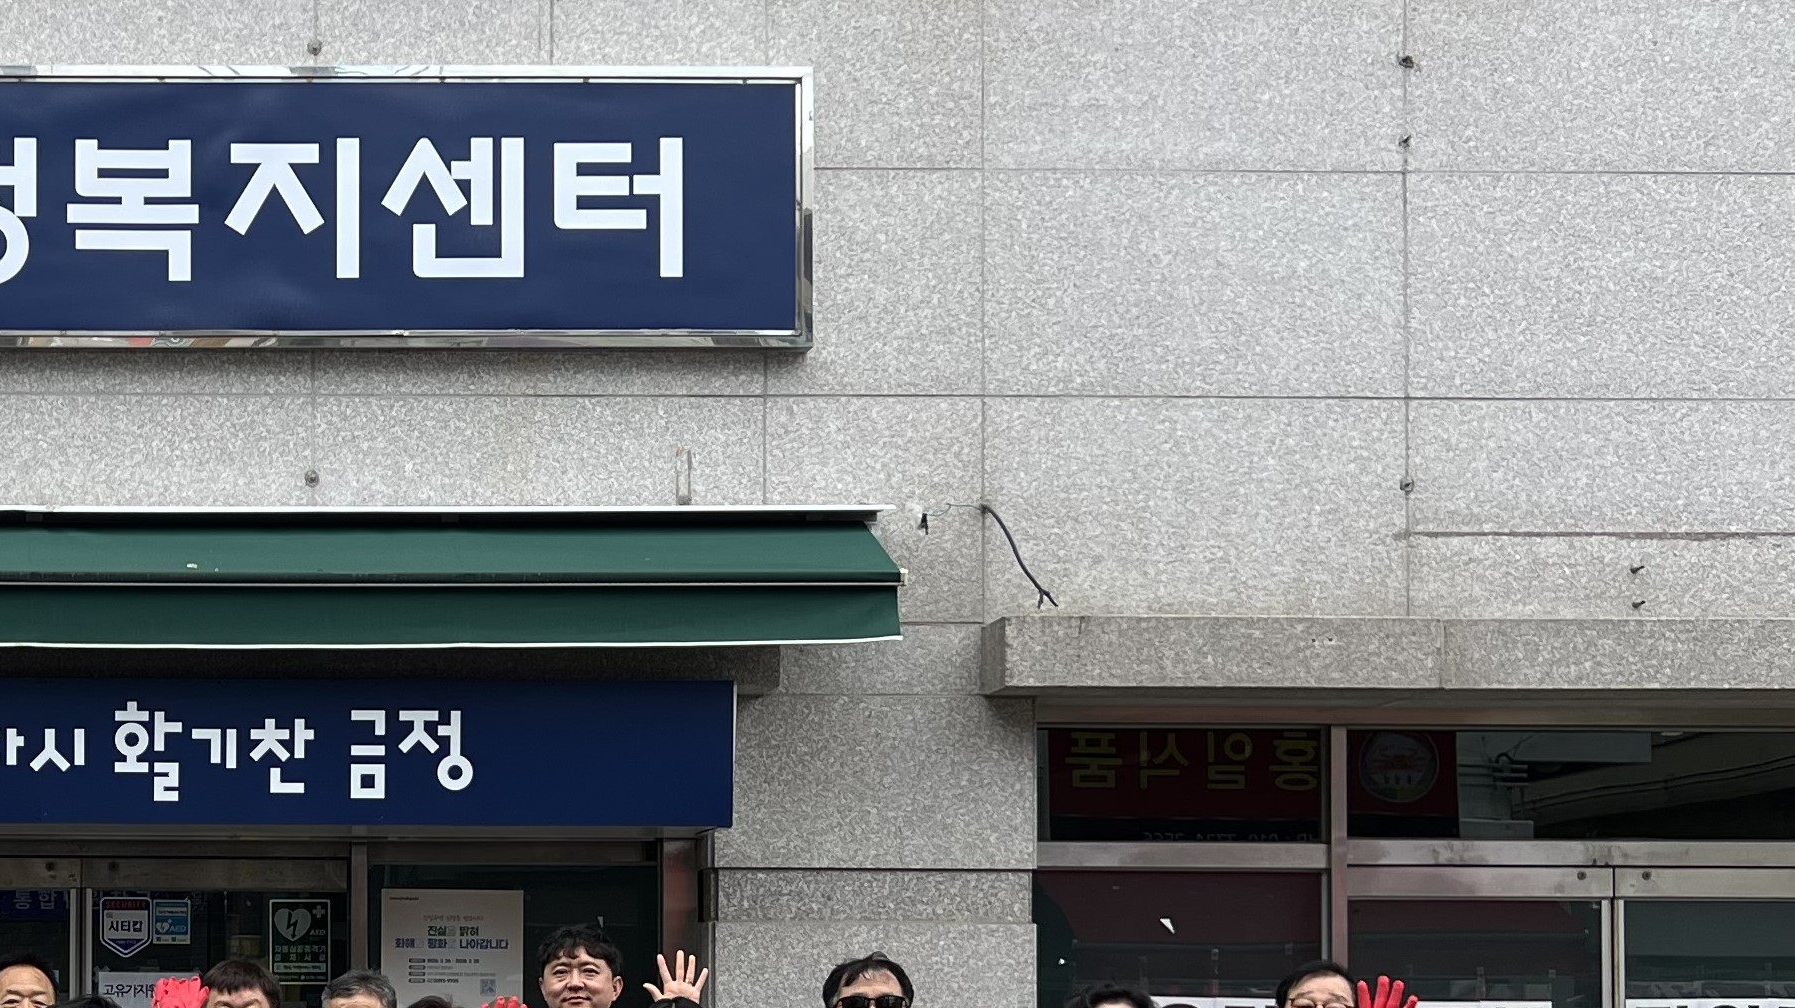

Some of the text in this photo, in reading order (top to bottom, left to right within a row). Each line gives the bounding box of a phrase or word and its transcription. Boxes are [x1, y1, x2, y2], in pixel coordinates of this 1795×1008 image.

[114, 701, 316, 802] 활기찬
[350, 709, 474, 799] 금정
[108, 920, 144, 932] 시티캅
[458, 938, 509, 950] 나아갑니다
